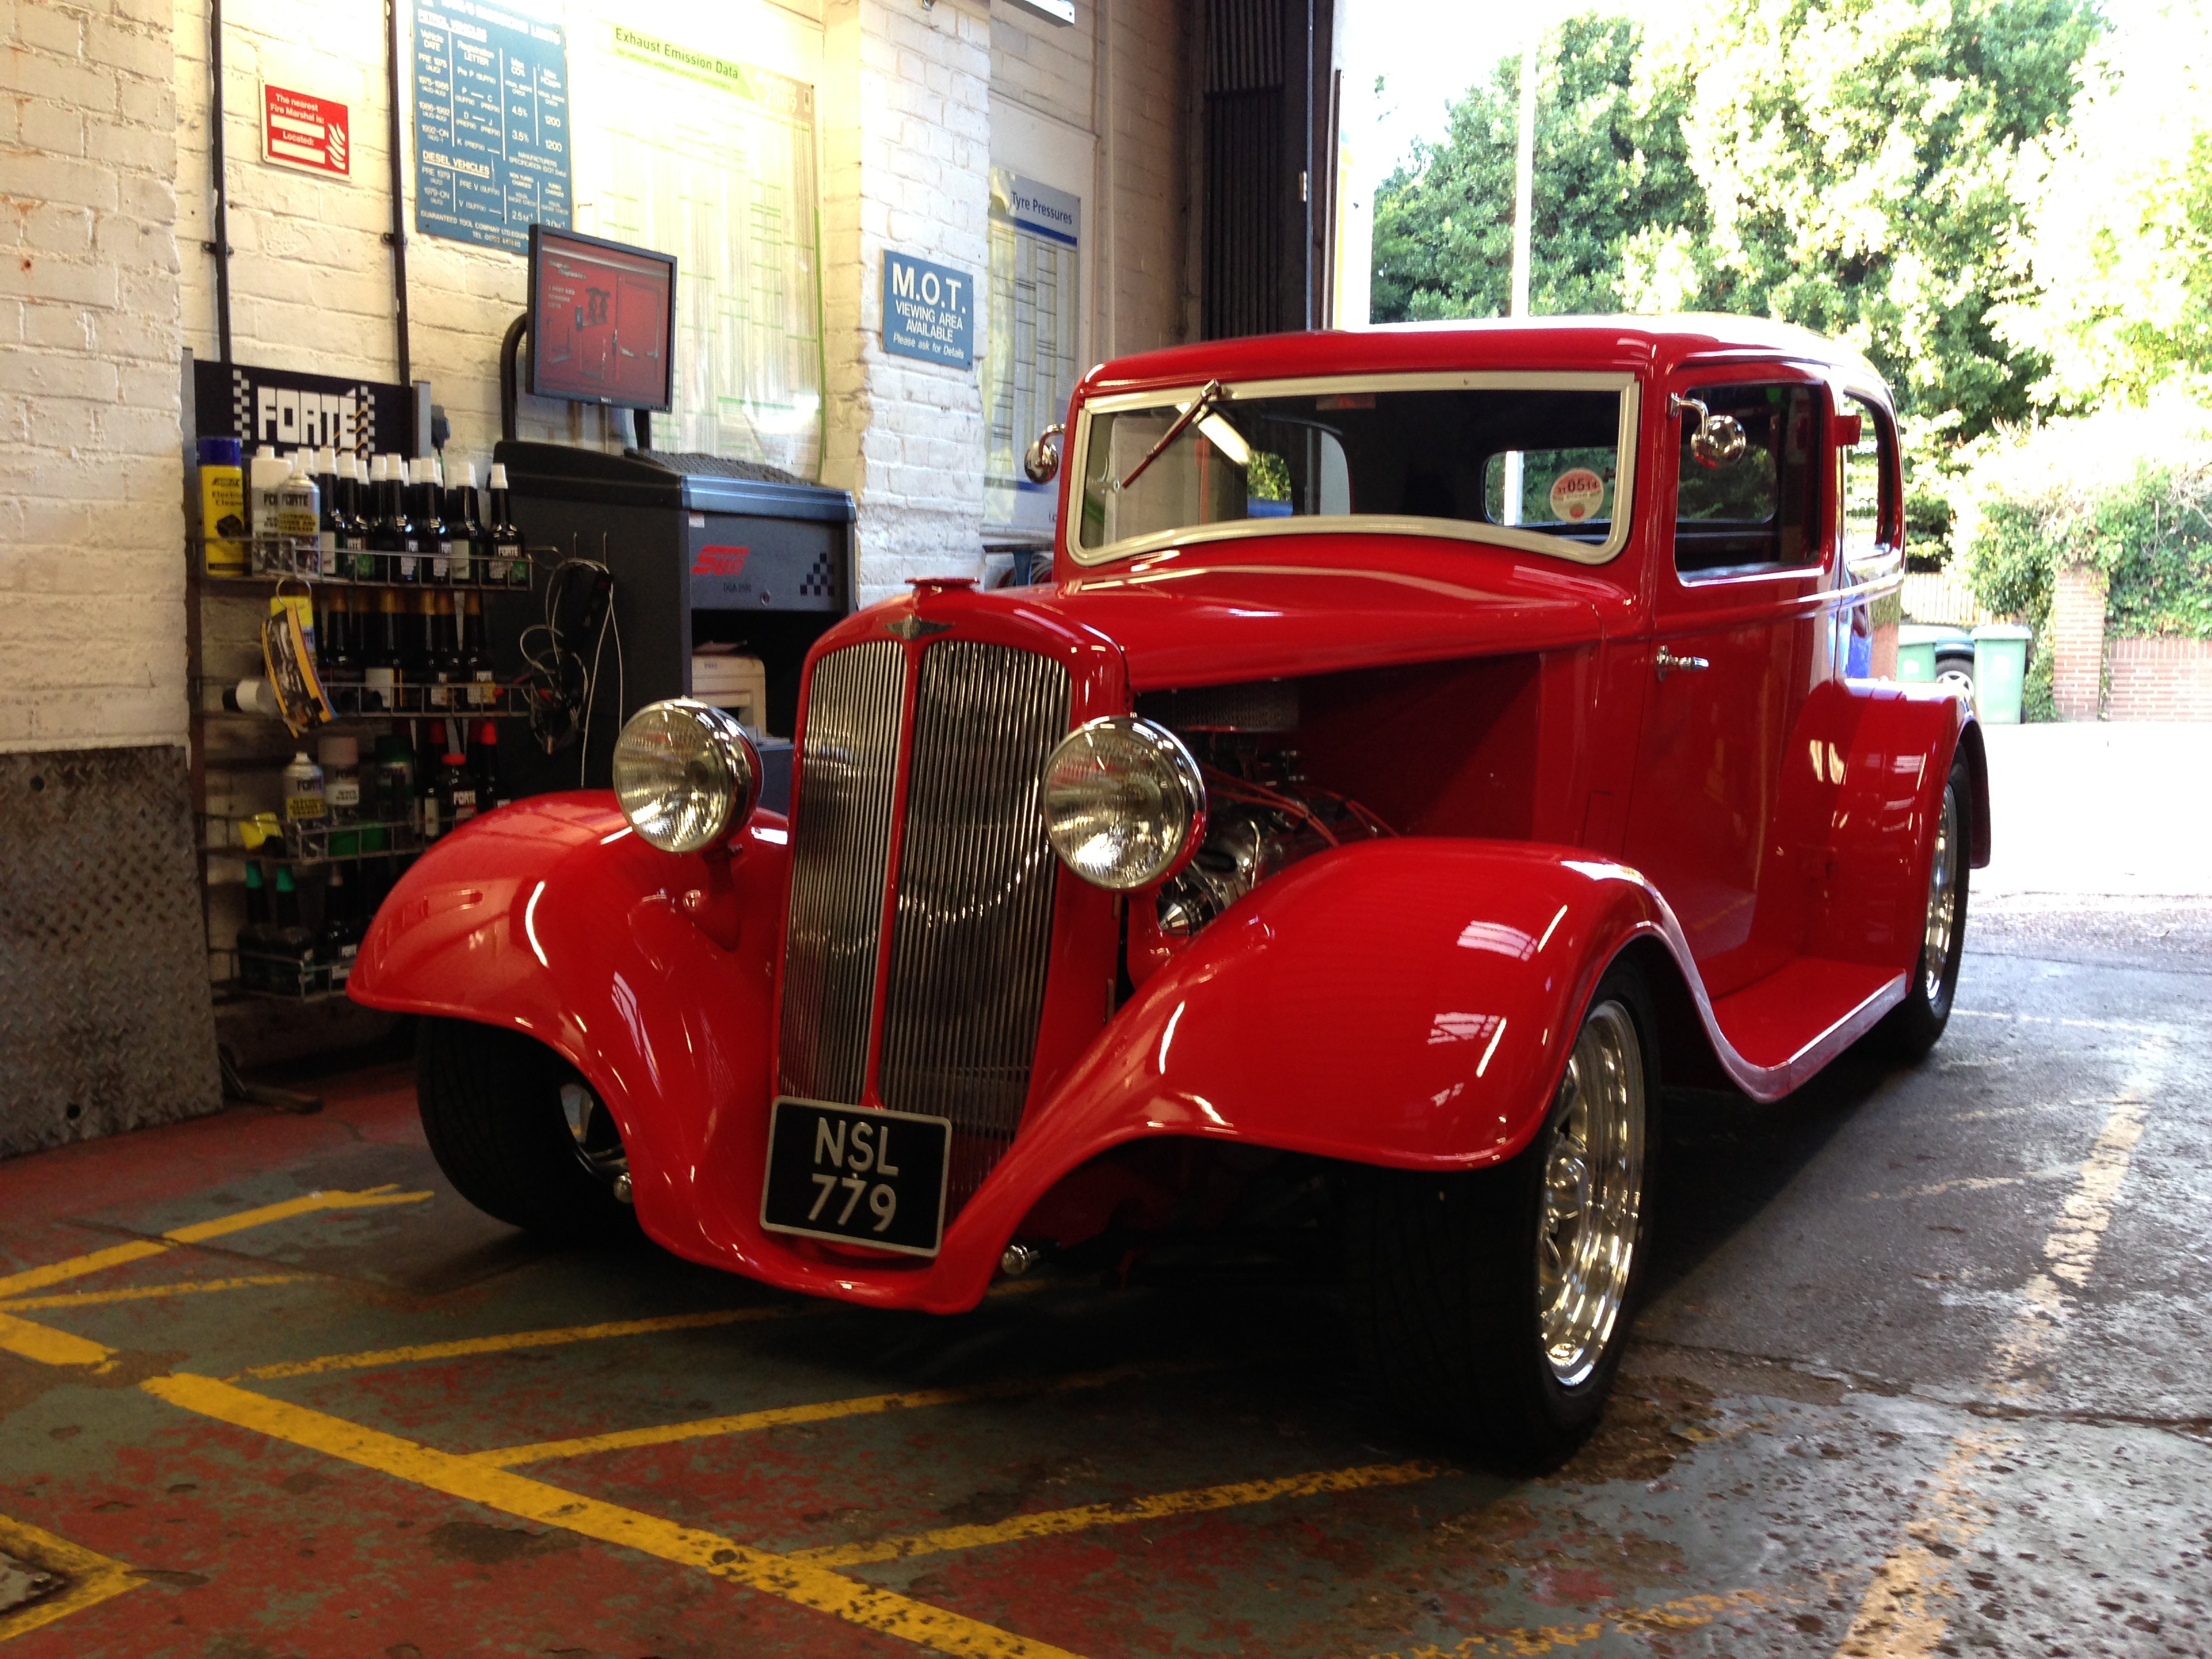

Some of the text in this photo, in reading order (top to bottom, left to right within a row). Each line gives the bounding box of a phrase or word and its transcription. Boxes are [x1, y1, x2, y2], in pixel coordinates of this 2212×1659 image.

[424, 39, 441, 52] DATE
[616, 27, 739, 79] Exhaust Emission Data
[464, 51, 489, 66] LETTER
[270, 103, 325, 124] Fire Marshal is:
[275, 93, 319, 112] The nearest
[545, 115, 561, 128] 1200
[283, 131, 314, 146] Located:
[545, 139, 562, 152] 1200
[422, 150, 490, 175] DIESEL VEHICLES
[422, 166, 435, 177] PRE
[459, 179, 472, 190] PRE
[1011, 191, 1073, 225] Tyre Pressures
[420, 210, 458, 224] GUARANTEED
[459, 218, 474, 228] TOOL
[474, 222, 500, 233] COMPANY
[893, 262, 966, 314] M.O.T.
[895, 300, 963, 331] VIEWING AREA
[906, 319, 954, 343] AVAILABLE
[893, 333, 964, 359] Please ask for Details
[815, 1117, 899, 1176] NSL
[808, 1173, 897, 1233] 779
